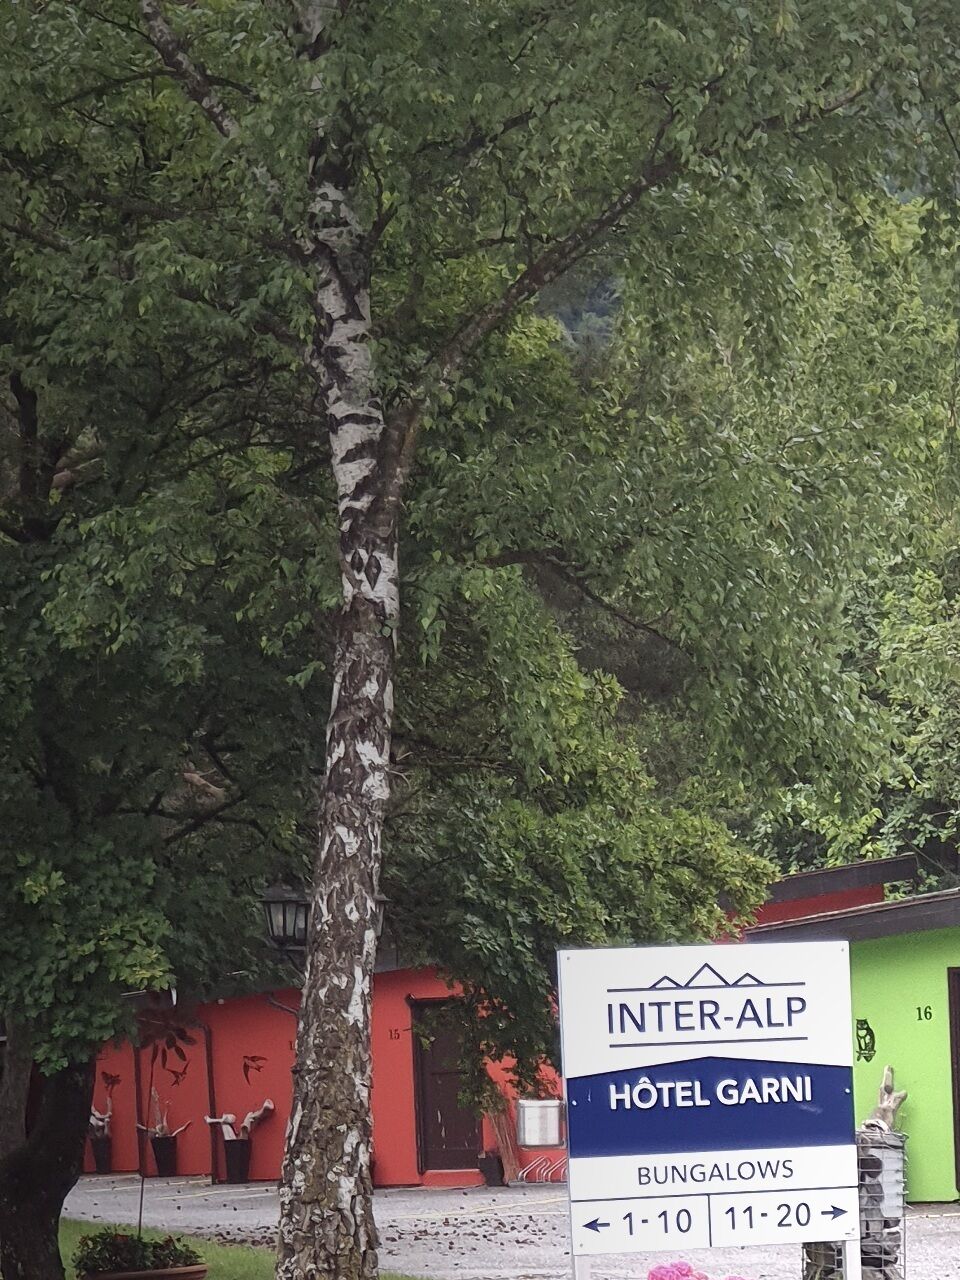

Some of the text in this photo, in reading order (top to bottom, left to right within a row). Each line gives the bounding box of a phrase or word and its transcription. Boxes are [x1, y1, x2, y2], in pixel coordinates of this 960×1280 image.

[607, 996, 807, 1034] INTER-ALP
[916, 1005, 933, 1021] 16
[389, 1028, 400, 1040] 15
[609, 1075, 812, 1110] HÔTEL GARNI
[637, 1159, 794, 1186] BUNGALOWS
